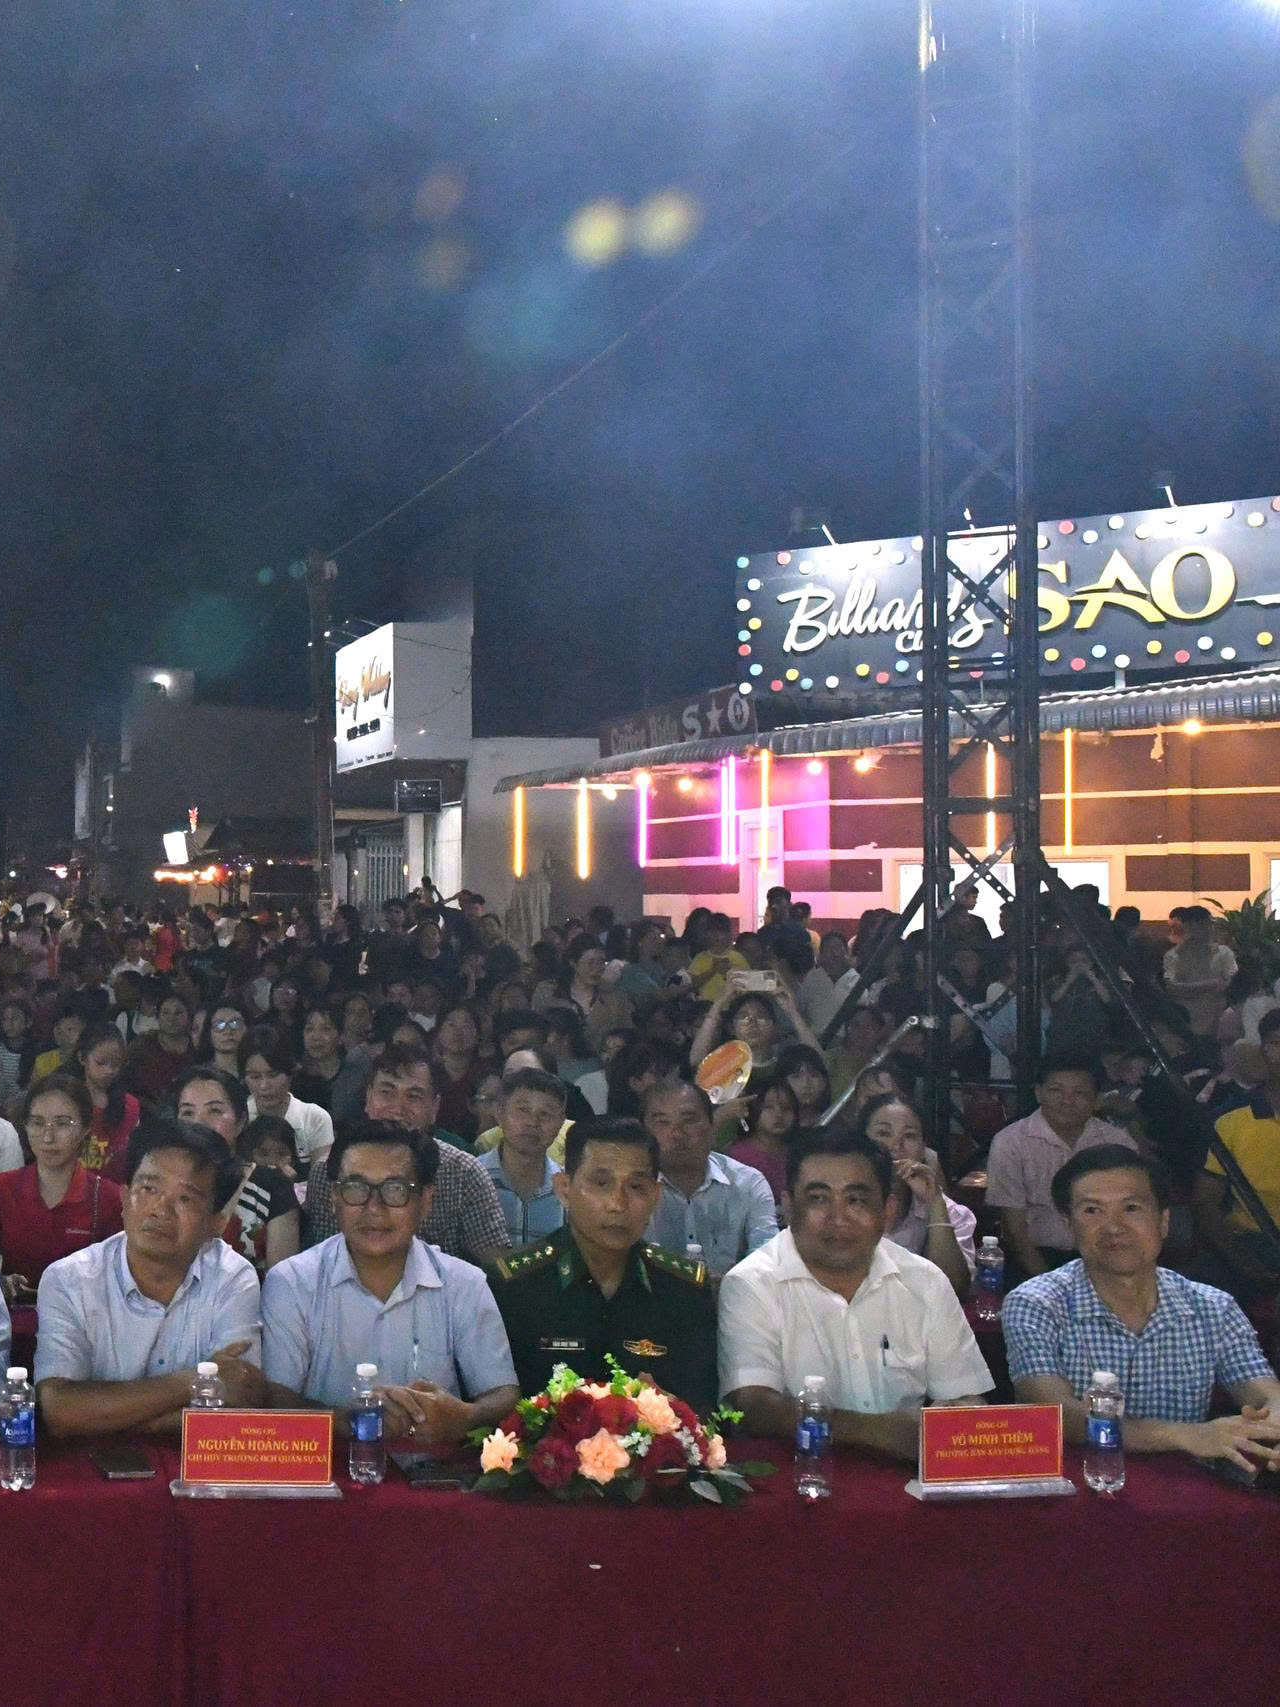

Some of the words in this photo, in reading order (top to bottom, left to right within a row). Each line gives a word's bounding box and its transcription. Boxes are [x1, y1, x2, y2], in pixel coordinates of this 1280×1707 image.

[1004, 545, 1236, 634] SAO
[197, 1436, 245, 1451] NGUYỄN
[248, 1438, 289, 1451] HOÀNG
[968, 1433, 999, 1446] MINH
[1001, 1430, 1033, 1444] THÊM
